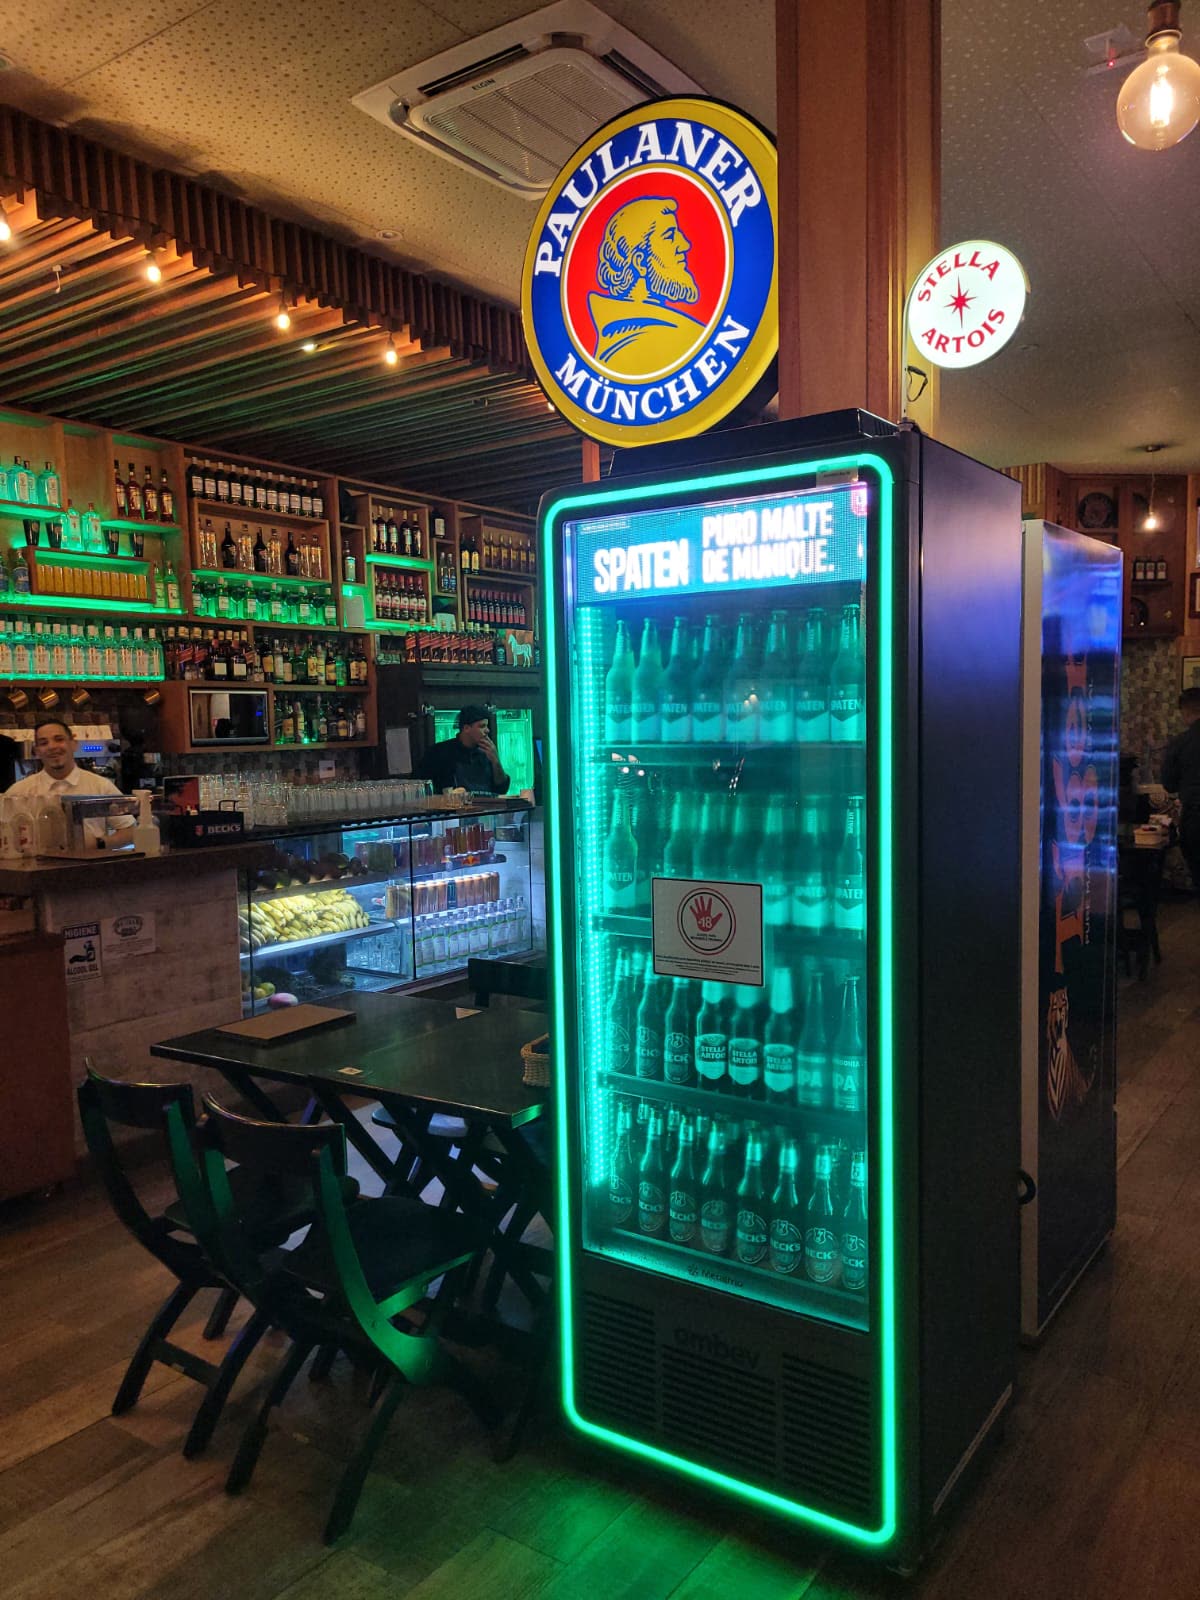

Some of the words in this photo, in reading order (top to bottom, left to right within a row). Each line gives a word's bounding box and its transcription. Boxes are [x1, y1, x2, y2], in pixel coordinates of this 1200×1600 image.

[534, 122, 762, 278] PAULANER
[917, 250, 1001, 302] STELLA
[921, 308, 1005, 353] ARTOIS
[555, 315, 750, 421] MÜNCHEN
[702, 510, 757, 548] PURO
[761, 501, 833, 543] MALTE
[593, 538, 690, 592] SPATEN
[702, 549, 729, 583] DE
